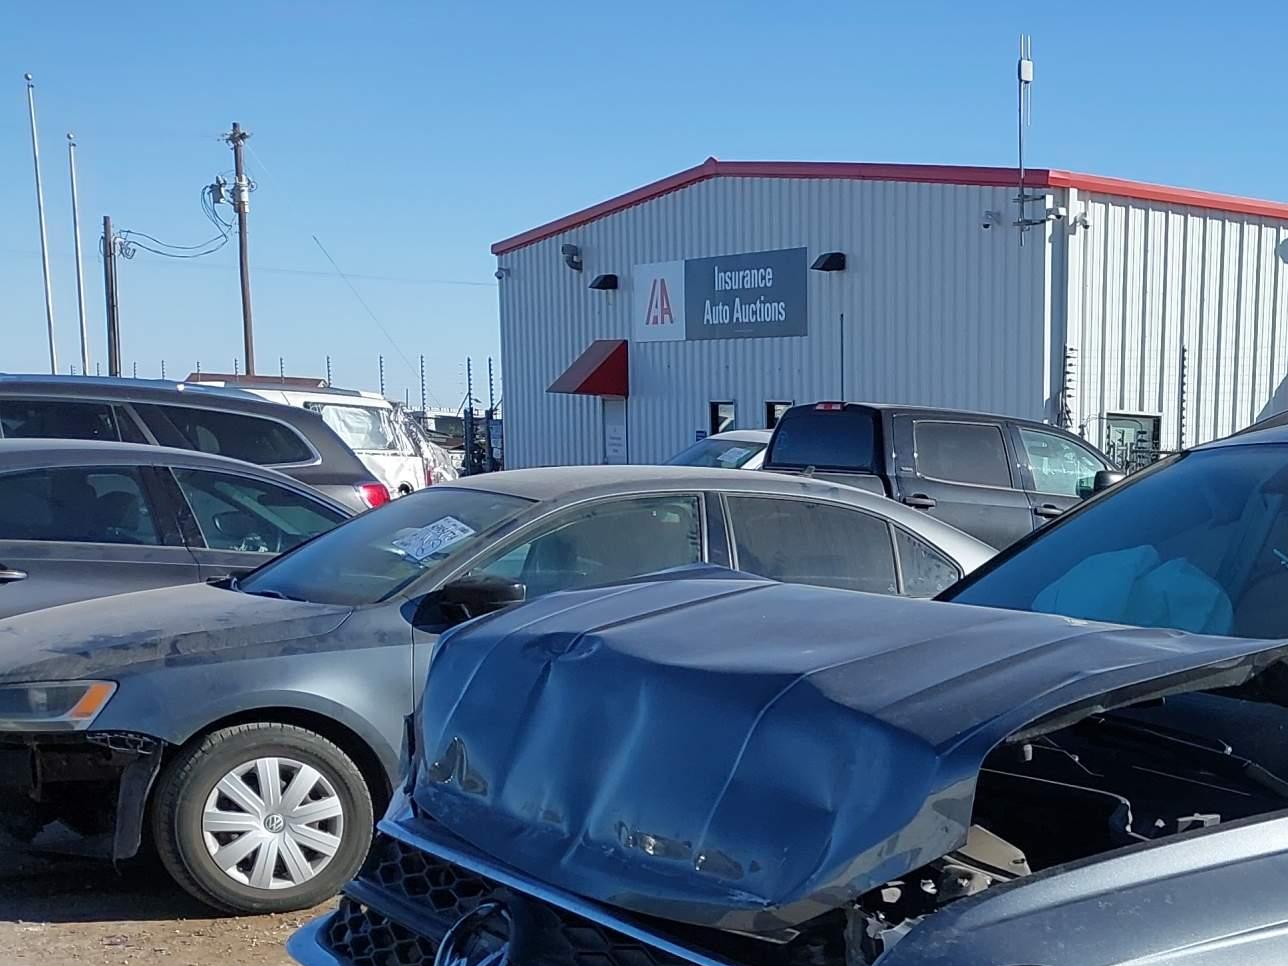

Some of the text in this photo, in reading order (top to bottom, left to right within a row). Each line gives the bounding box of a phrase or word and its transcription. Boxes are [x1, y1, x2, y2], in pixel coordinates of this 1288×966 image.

[714, 266, 773, 291] Insurance
[703, 296, 786, 325] Auto Auctions
